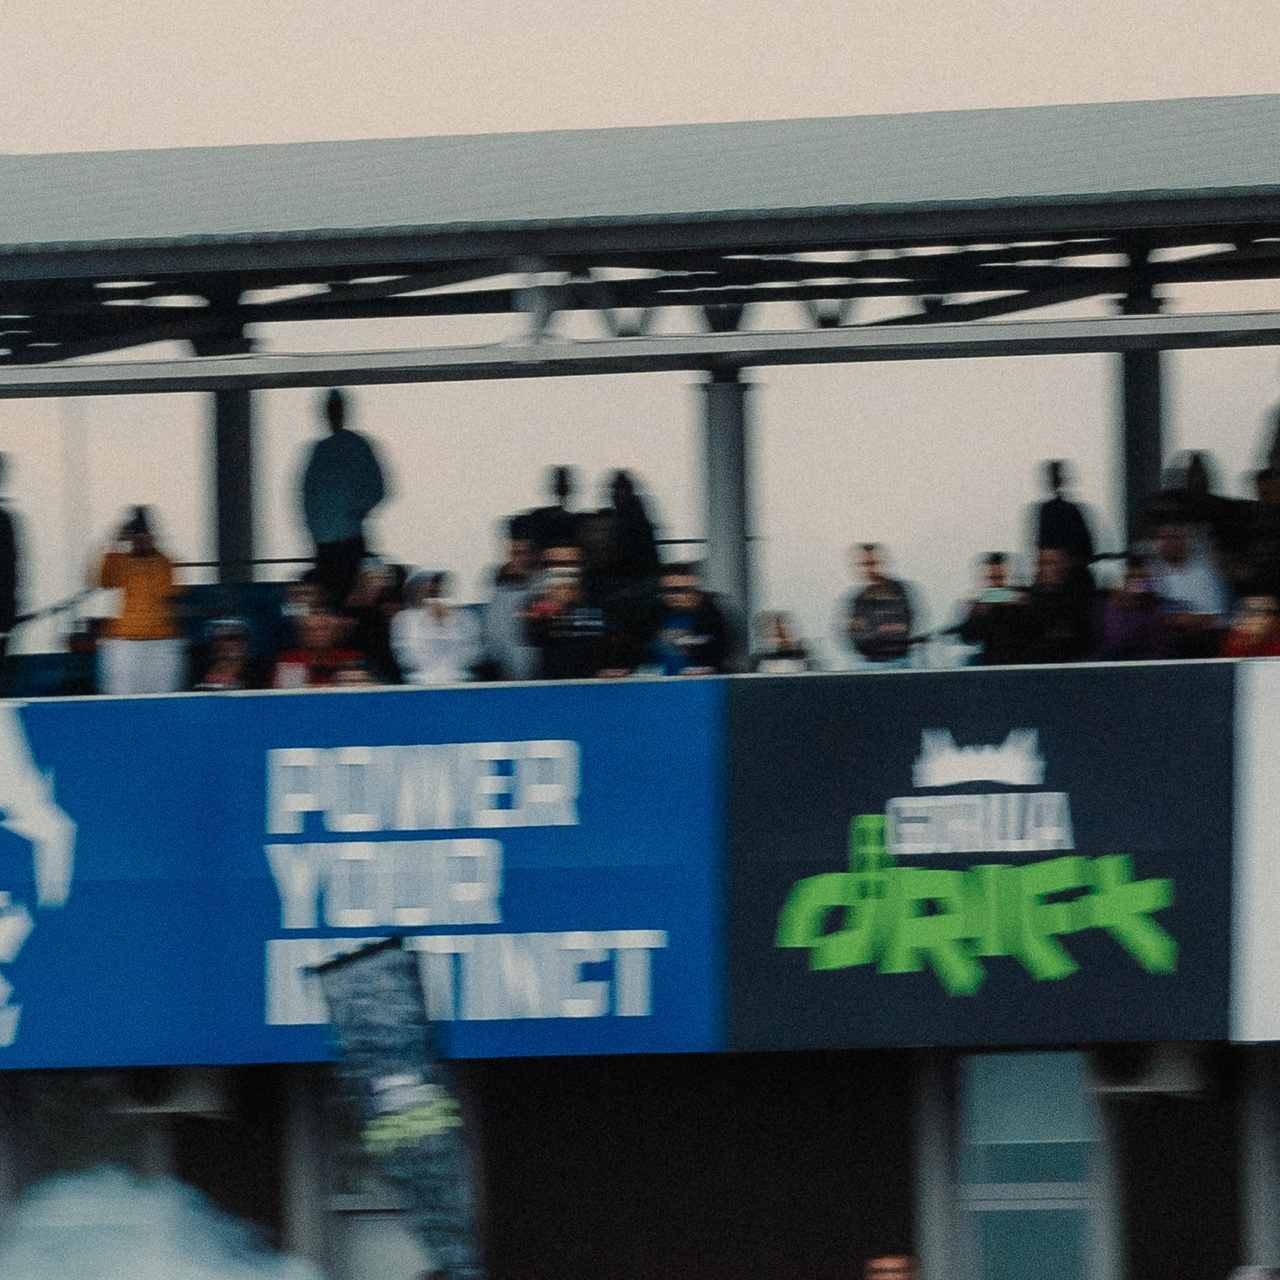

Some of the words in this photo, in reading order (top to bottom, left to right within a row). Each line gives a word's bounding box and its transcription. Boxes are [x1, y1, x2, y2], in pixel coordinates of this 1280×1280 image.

[265, 739, 582, 834] POWER
[263, 838, 505, 929] YOUR
[265, 928, 670, 1025] ITINCT
